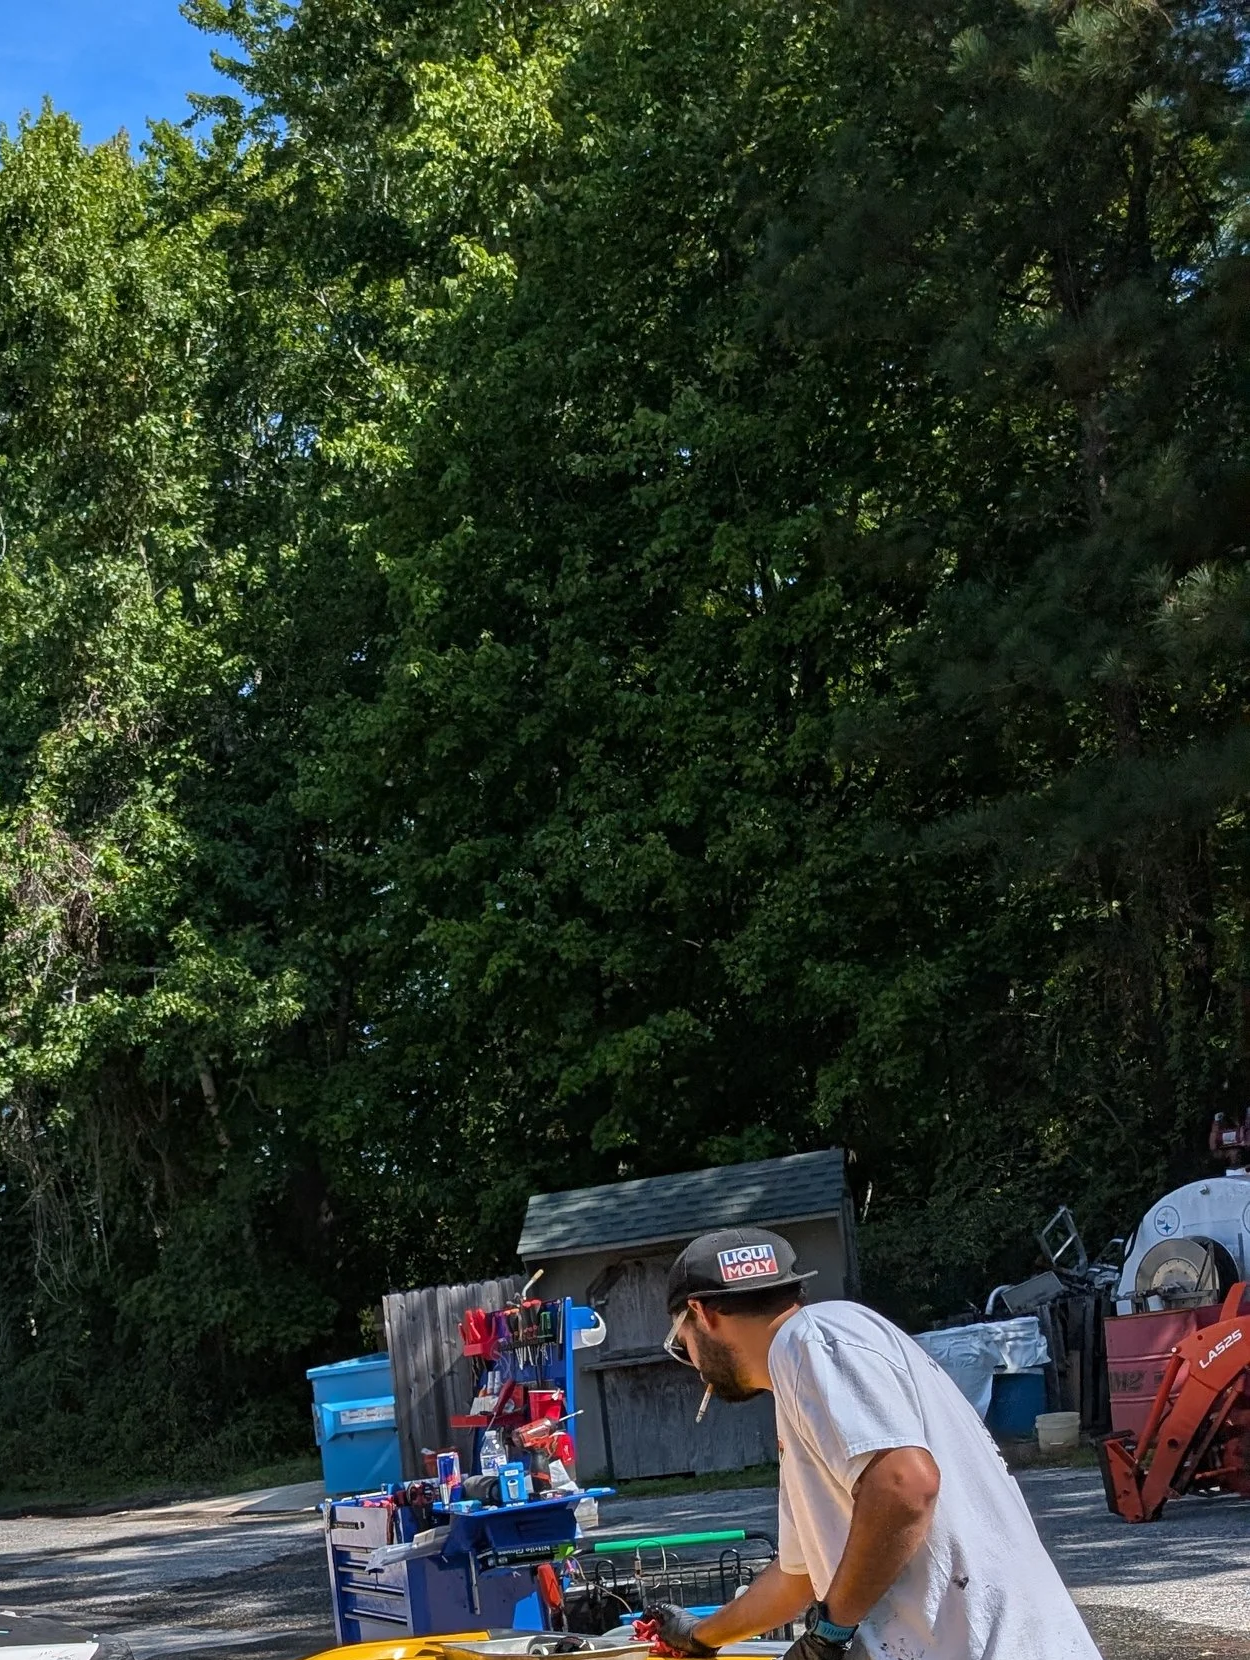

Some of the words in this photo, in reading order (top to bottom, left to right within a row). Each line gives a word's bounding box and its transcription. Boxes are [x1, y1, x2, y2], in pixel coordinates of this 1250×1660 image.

[723, 1247, 769, 1265] LIQUI
[726, 1260, 772, 1278] MOLY
[1198, 1329, 1243, 1369] LA525
